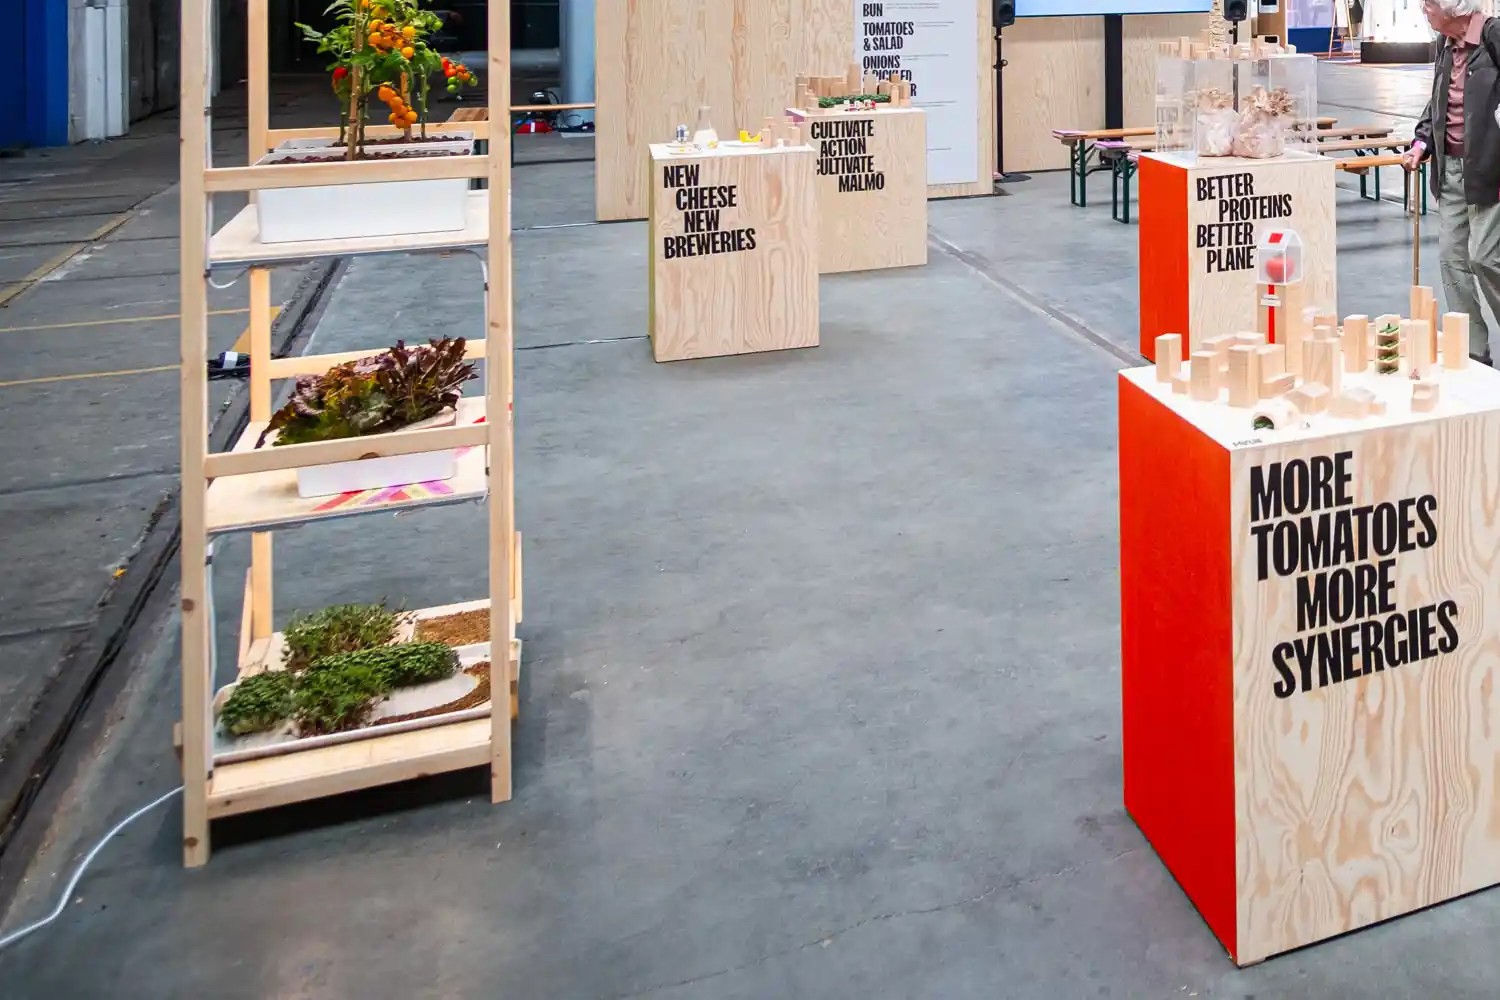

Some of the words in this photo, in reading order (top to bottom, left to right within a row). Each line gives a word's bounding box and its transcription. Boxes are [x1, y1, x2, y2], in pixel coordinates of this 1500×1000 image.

[863, 3, 883, 17] BUN
[863, 21, 914, 36] TOMATOES
[863, 38, 871, 51] &
[873, 36, 903, 50] SALAD
[863, 55, 901, 70] ONIONS
[811, 120, 874, 139] CULTIVATE
[820, 138, 866, 157] ACTION
[664, 164, 699, 188] NEW
[839, 171, 884, 192] MALMÖ
[1197, 173, 1253, 201] BETTER
[676, 186, 736, 210] CHEESE
[1219, 194, 1292, 222] PROTEINS
[684, 210, 719, 233] NEW
[664, 228, 756, 259] BREWERIES
[1197, 222, 1253, 248] BETTER
[1207, 246, 1257, 273] PLANE
[1249, 450, 1354, 522] MORE
[1250, 494, 1438, 581] TOMATOES
[1295, 558, 1397, 632] MORE
[1272, 600, 1459, 699] SYNERGIES
